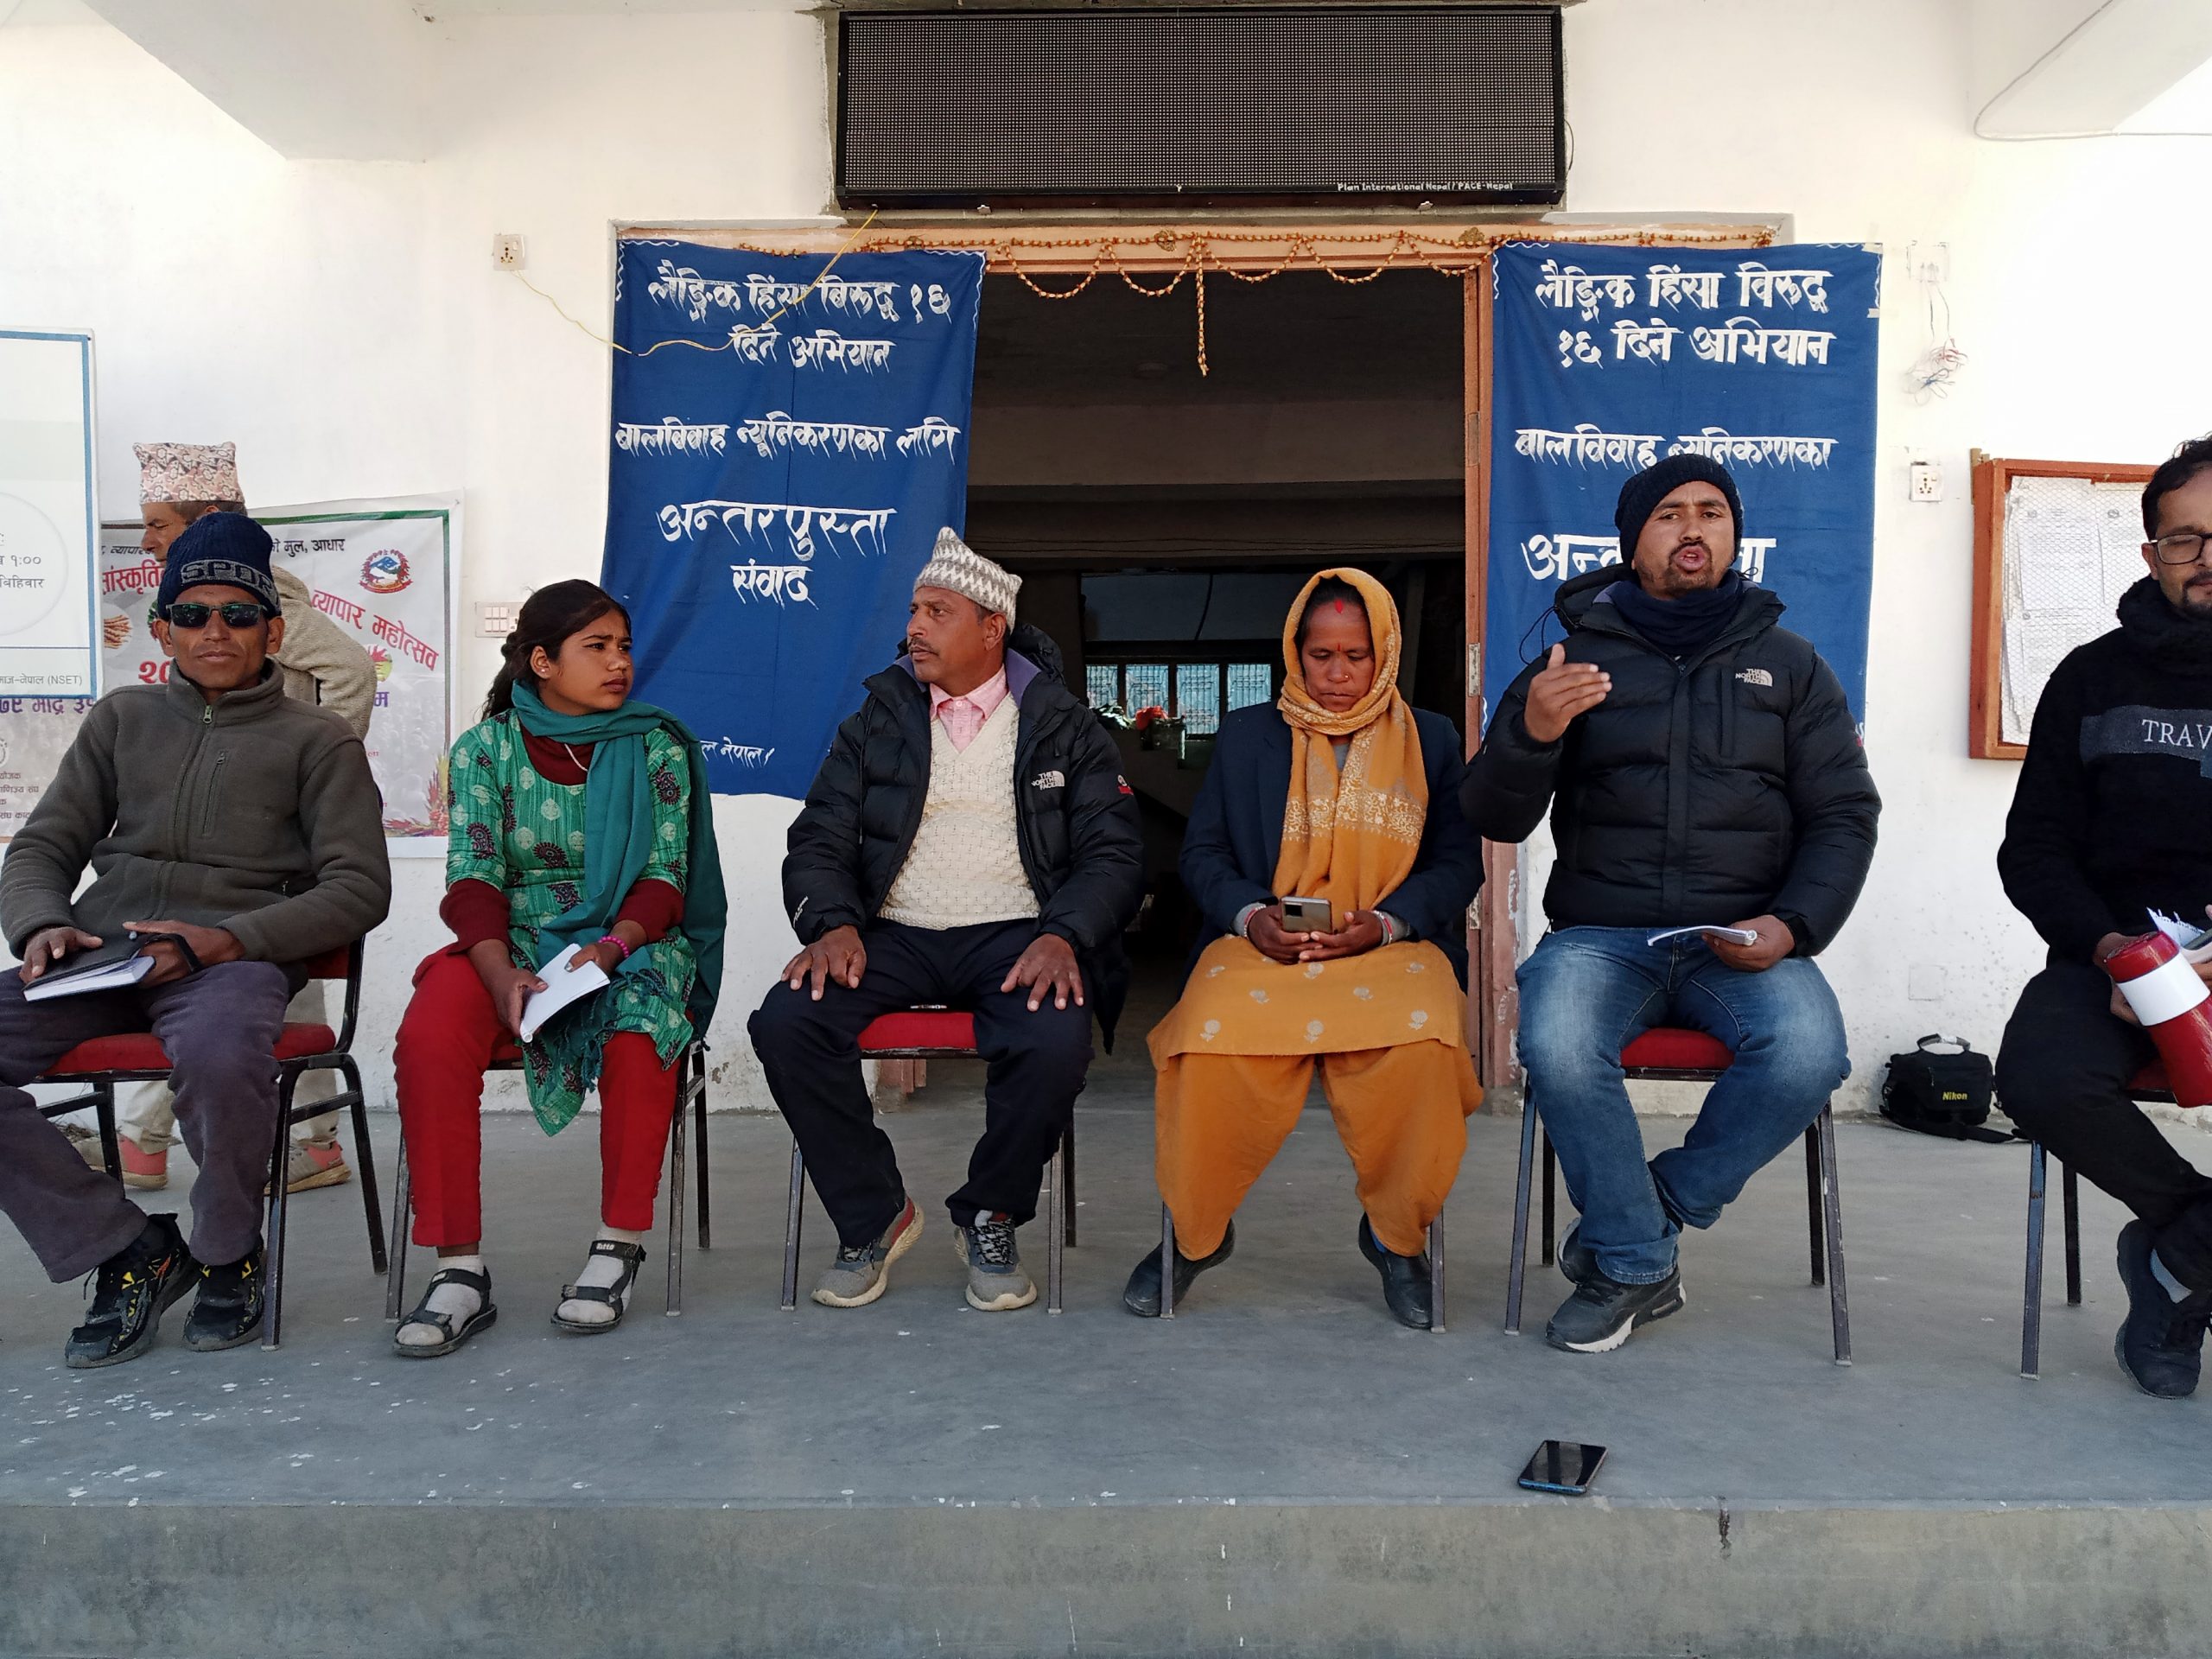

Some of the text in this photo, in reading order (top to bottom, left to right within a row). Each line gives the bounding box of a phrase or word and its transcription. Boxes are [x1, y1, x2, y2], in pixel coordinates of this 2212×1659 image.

[1362, 182, 1424, 191] International
[1645, 264, 1726, 312] हिंसा
[728, 322, 897, 373] दिने अभियान
[1559, 316, 1837, 369] १६ दिने अभियान
[896, 416, 961, 466] लागि
[730, 558, 819, 610] संवाद
[48, 675, 83, 685] (NSET)
[1942, 1091, 1967, 1100] Nikon
